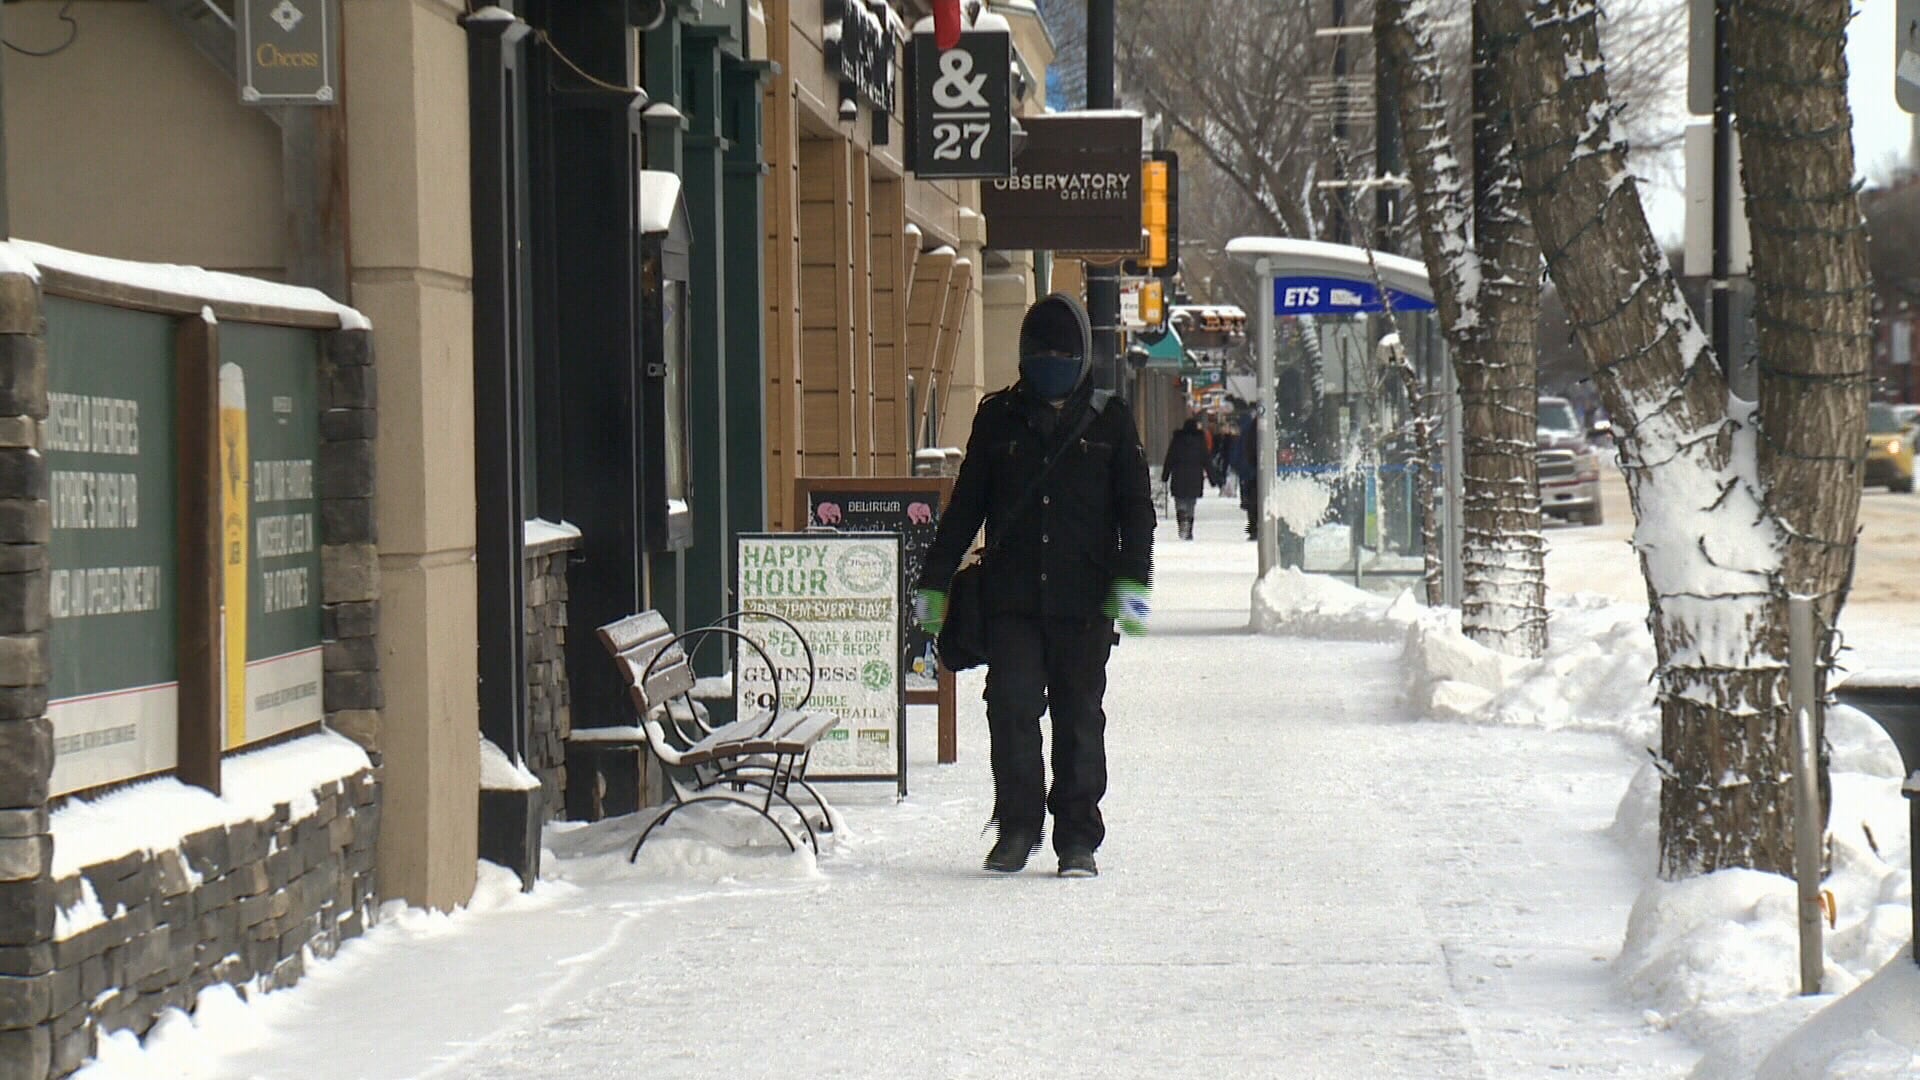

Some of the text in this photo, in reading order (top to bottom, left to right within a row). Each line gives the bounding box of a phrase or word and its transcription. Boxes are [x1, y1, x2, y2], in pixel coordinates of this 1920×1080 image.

[256, 43, 319, 67] Cheers
[932, 48, 990, 109] &
[932, 122, 991, 160] 27
[993, 173, 1130, 190] OBSERVATORY
[1060, 189, 1128, 200] Opticians
[1284, 286, 1320, 307] ETS
[848, 501, 901, 513] DELIRIUM
[744, 545, 828, 568] HAPPY
[744, 568, 828, 595] HOUR
[815, 602, 854, 617] EVERY
[843, 630, 850, 642] &
[744, 666, 857, 682] GUINNESS
